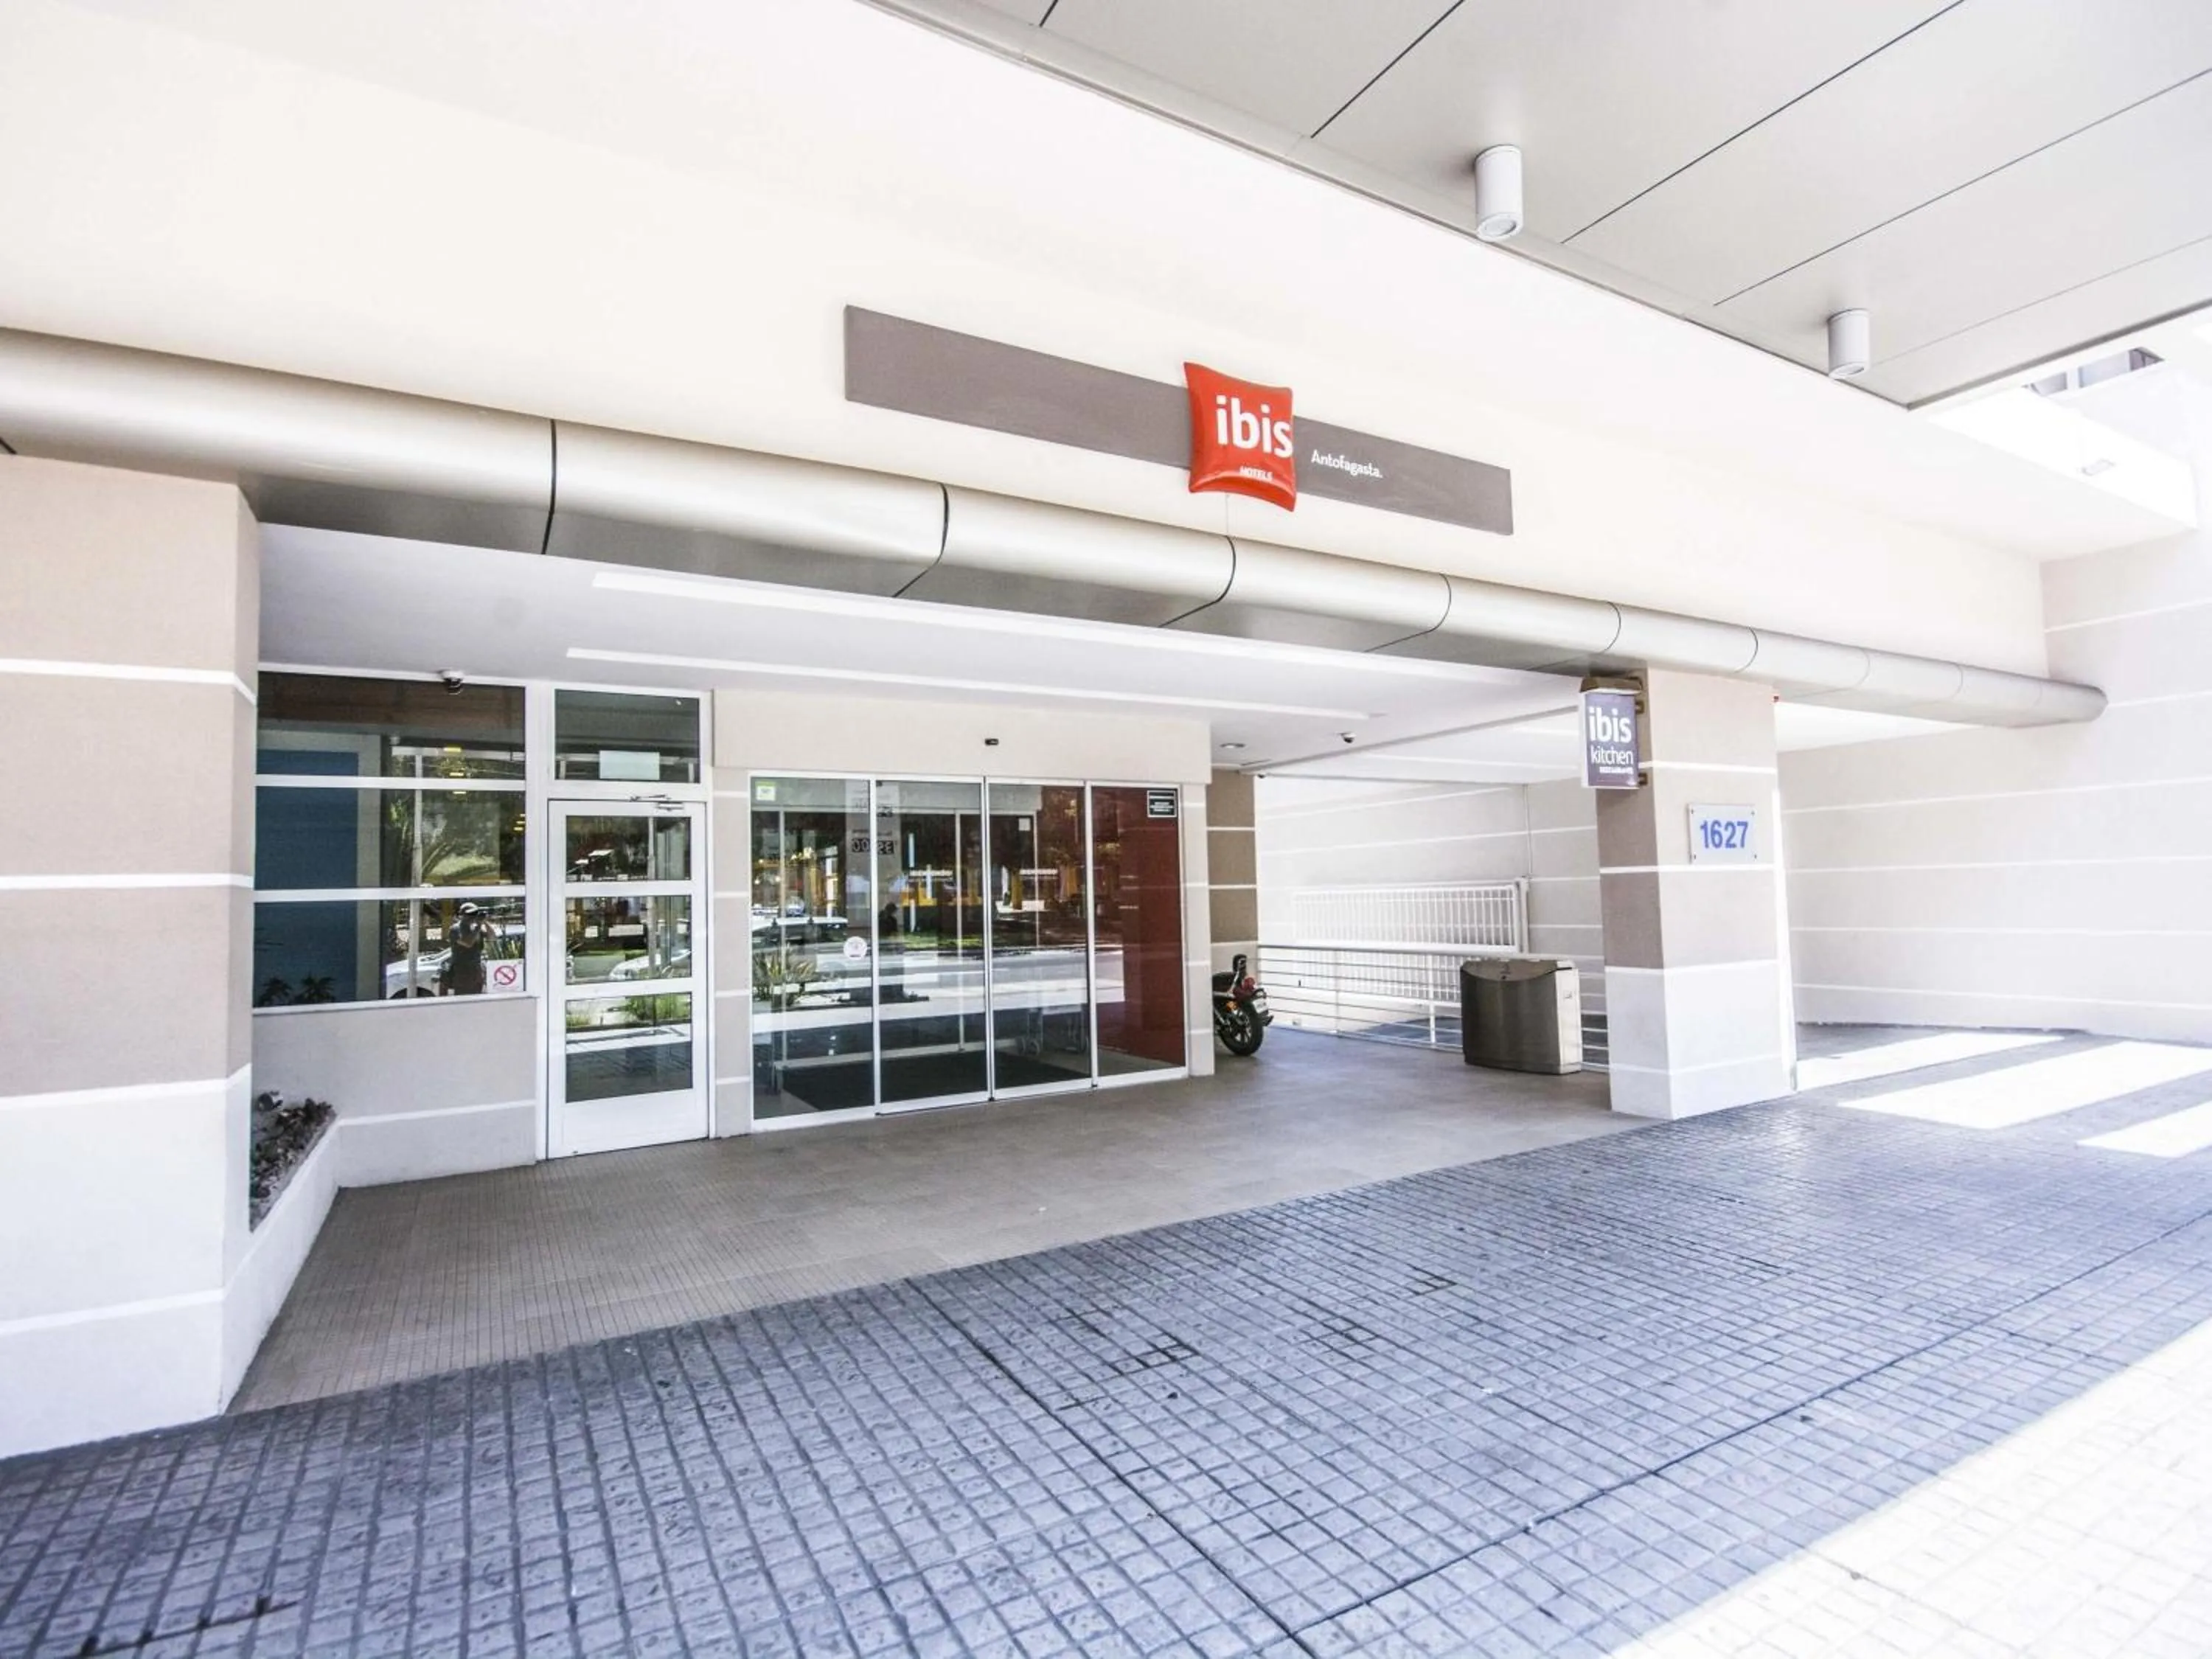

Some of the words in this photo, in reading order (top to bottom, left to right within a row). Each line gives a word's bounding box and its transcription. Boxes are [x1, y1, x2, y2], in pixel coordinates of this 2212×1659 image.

[1216, 395, 1293, 458] ibis
[1311, 449, 1382, 478] Antofagasta.
[1588, 706, 1632, 743] ibis
[1590, 745, 1633, 765] kitchen
[1700, 820, 1748, 849] 1627
